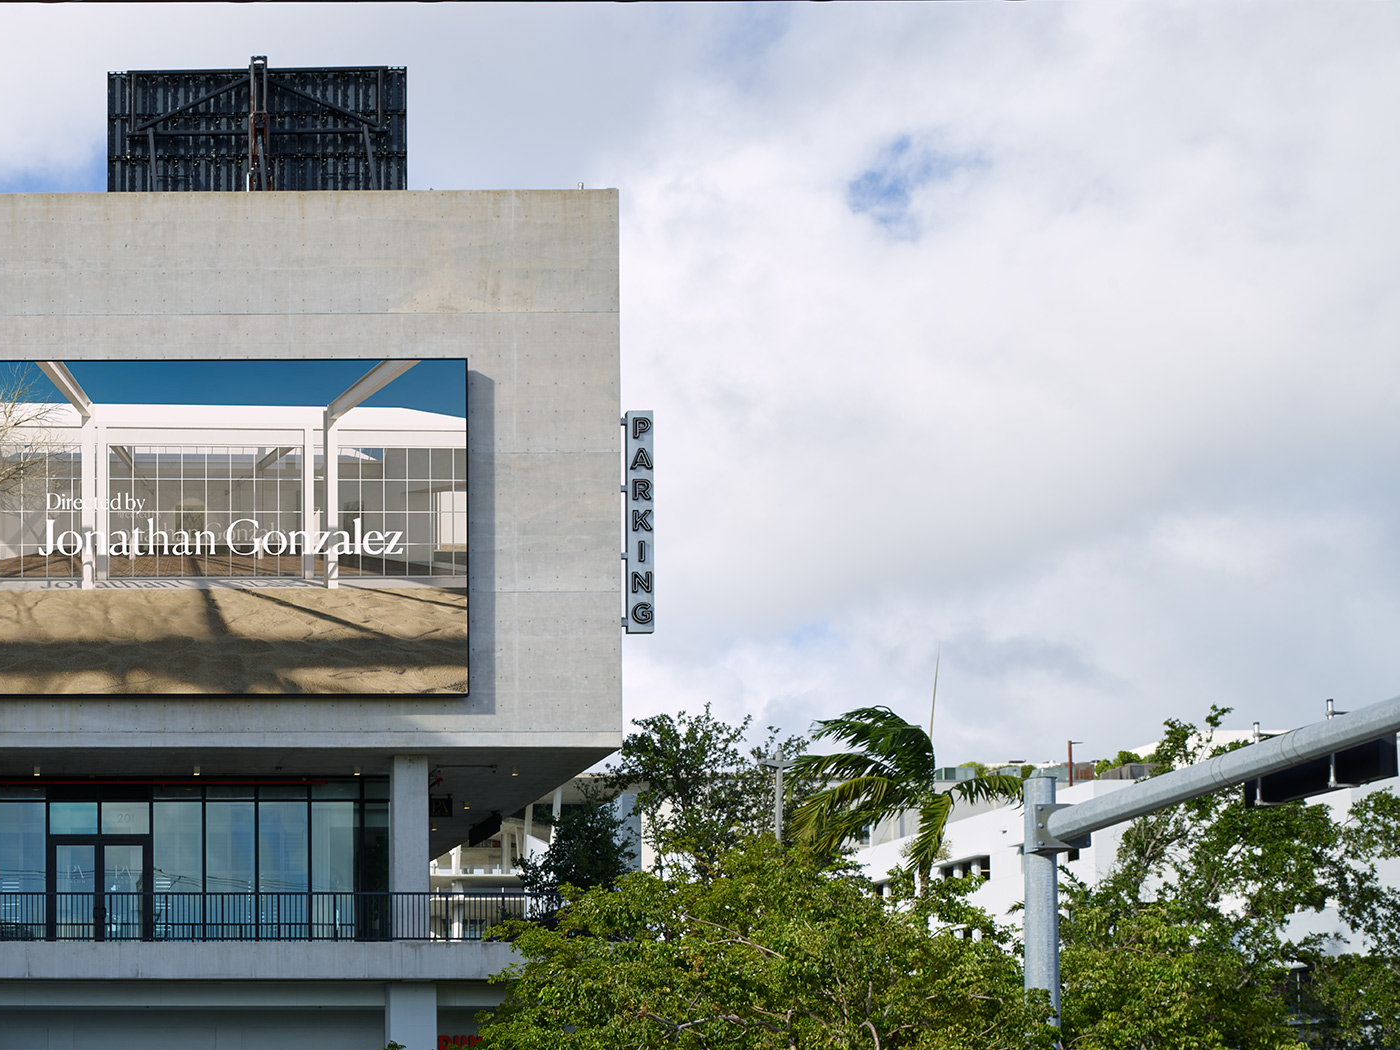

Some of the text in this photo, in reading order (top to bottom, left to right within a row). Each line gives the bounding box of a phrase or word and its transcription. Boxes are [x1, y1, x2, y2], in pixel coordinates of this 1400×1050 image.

[46, 492, 146, 514] Directed by
[630, 417, 653, 625] PARKING
[38, 518, 404, 556] Jonathan Gonzalez
[116, 813, 134, 823] 201
